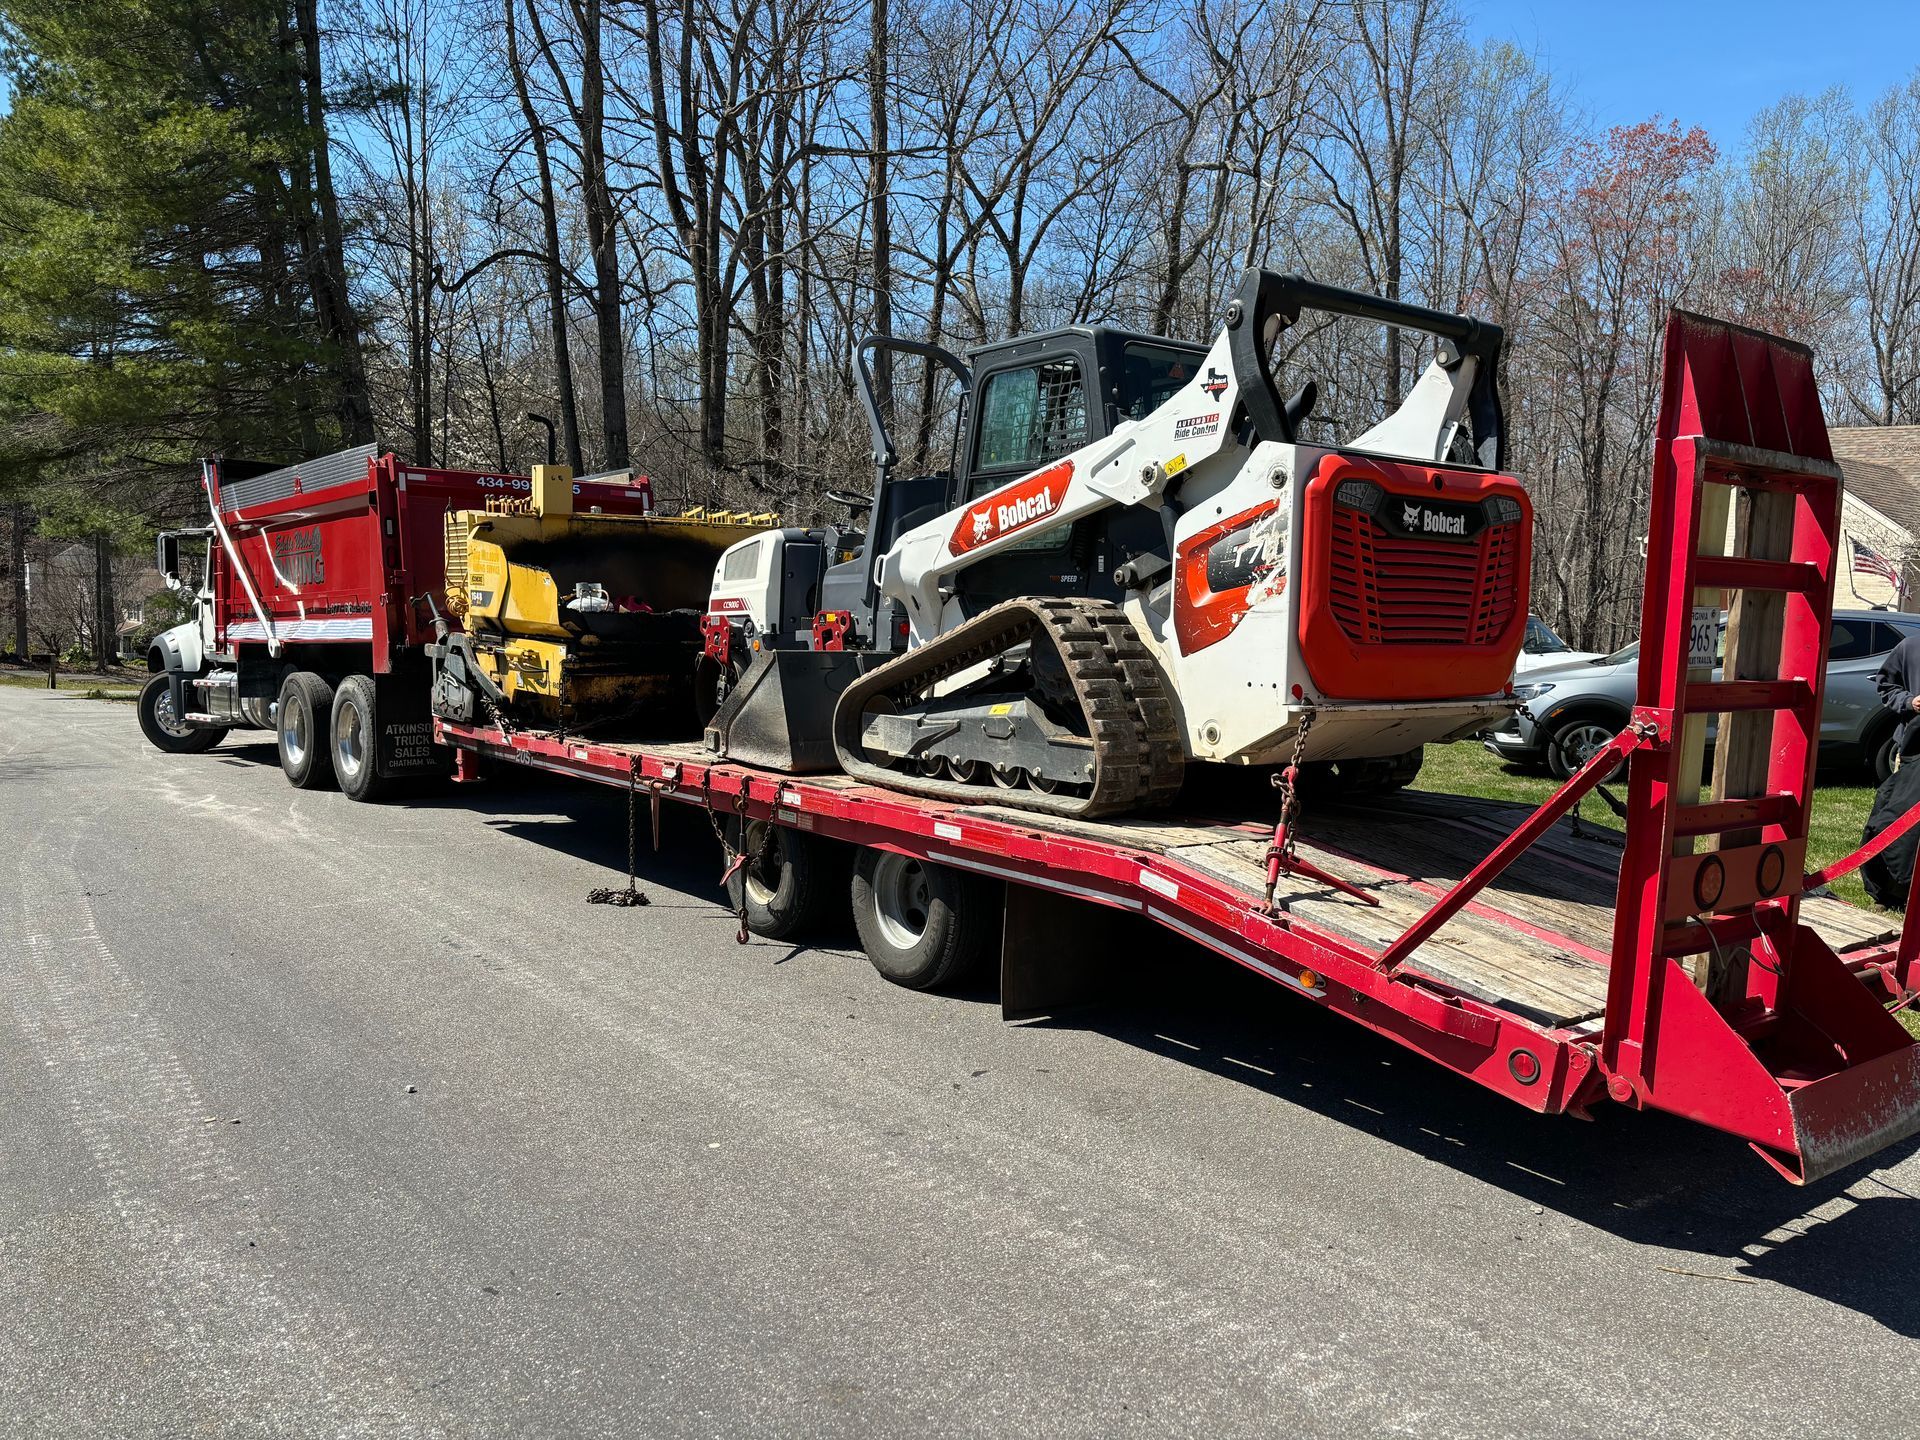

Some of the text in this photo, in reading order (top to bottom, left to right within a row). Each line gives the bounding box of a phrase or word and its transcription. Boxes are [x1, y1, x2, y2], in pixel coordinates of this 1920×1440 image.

[1176, 413, 1219, 428] AUTOMATIC
[1175, 423, 1219, 439] Ride Control
[997, 486, 1053, 531] Bobcat
[1423, 510, 1465, 535] Bobcat
[1060, 575, 1078, 583] SPEED
[385, 723, 432, 735] ATKINSO
[394, 735, 430, 746] TRUCK
[395, 747, 430, 758] SALES
[389, 759, 423, 768] CHATHAM
